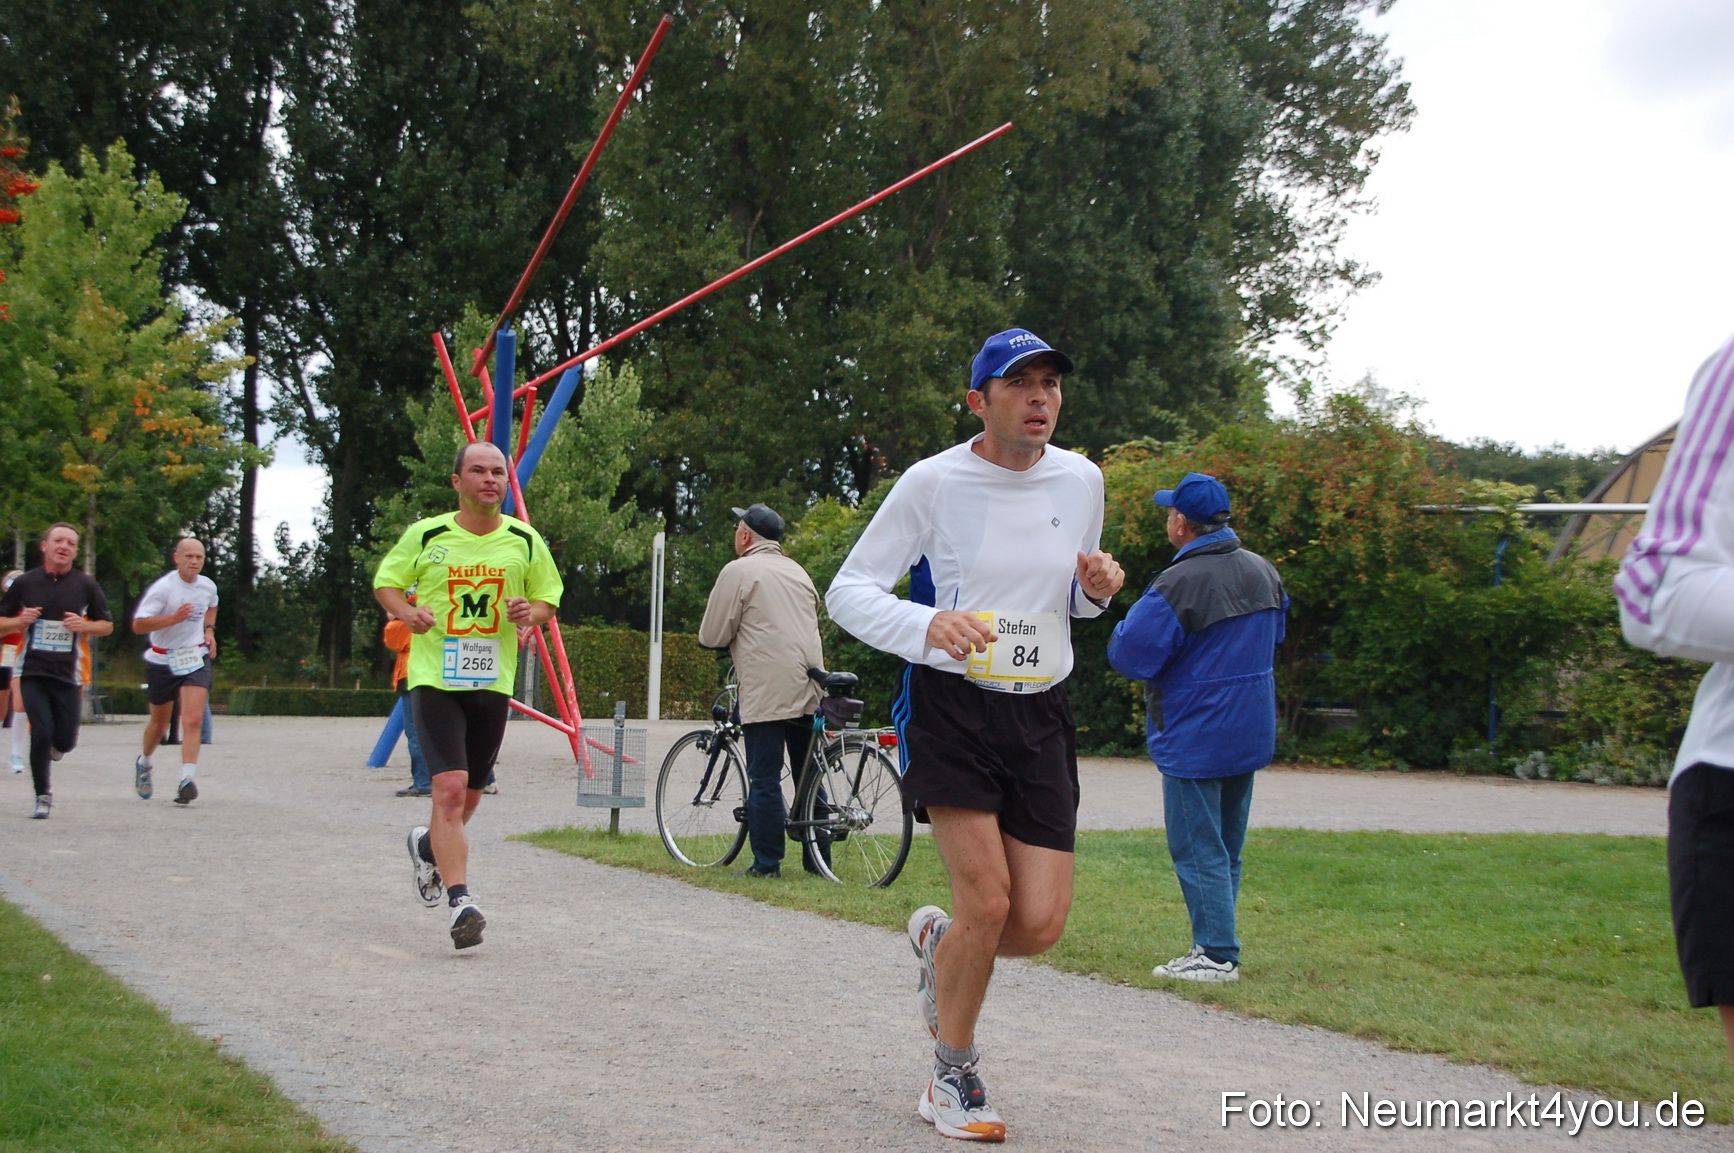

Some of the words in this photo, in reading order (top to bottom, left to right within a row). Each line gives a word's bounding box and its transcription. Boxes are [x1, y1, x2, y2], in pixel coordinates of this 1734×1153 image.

[447, 564, 507, 578] Müller
[460, 593, 491, 618] M
[998, 618, 1036, 635] Stefan
[45, 632, 70, 641] 2282
[462, 641, 493, 655] Wolfgang
[461, 656, 494, 671] 2562
[1012, 644, 1040, 668] 84
